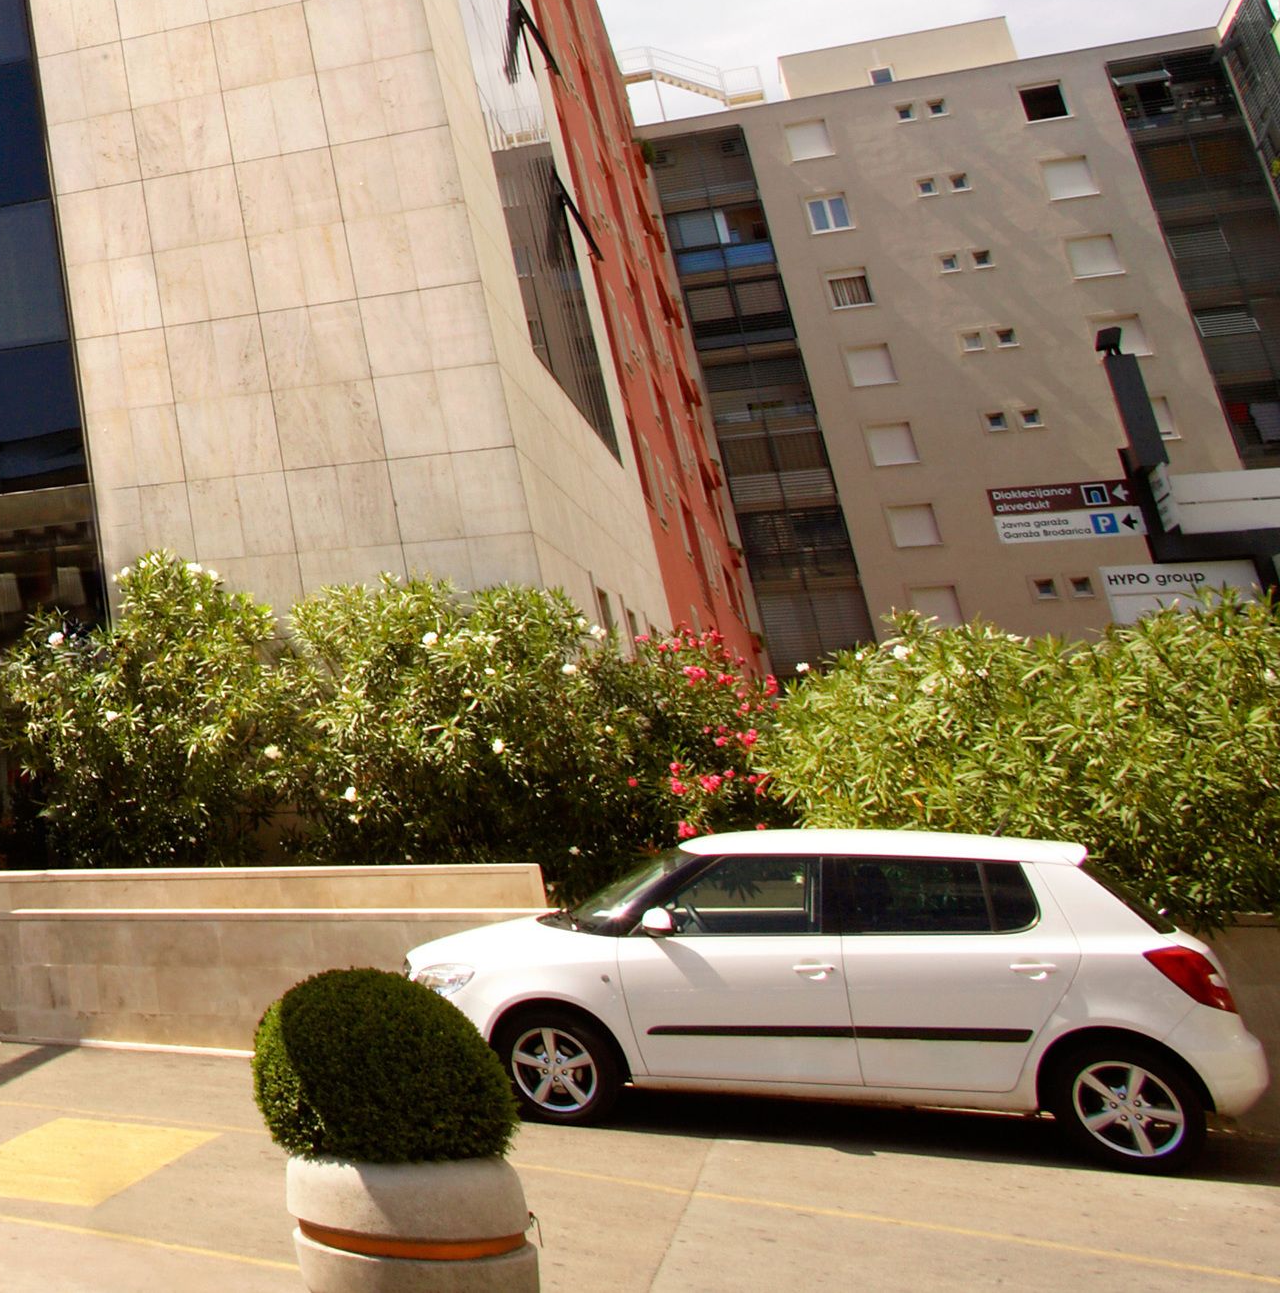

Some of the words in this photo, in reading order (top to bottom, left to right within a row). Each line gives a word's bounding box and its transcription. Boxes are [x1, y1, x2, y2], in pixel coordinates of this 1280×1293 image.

[992, 487, 1072, 500] Dioklecijanov
[996, 500, 1051, 513] akvedukt
[1001, 521, 1031, 529] Javna
[1033, 517, 1069, 528] garaža
[1097, 516, 1111, 532] P
[1003, 530, 1040, 539] Garaža
[1042, 527, 1092, 537] Brodarica
[1107, 573, 1150, 586] HYPO
[1155, 572, 1205, 586] group
